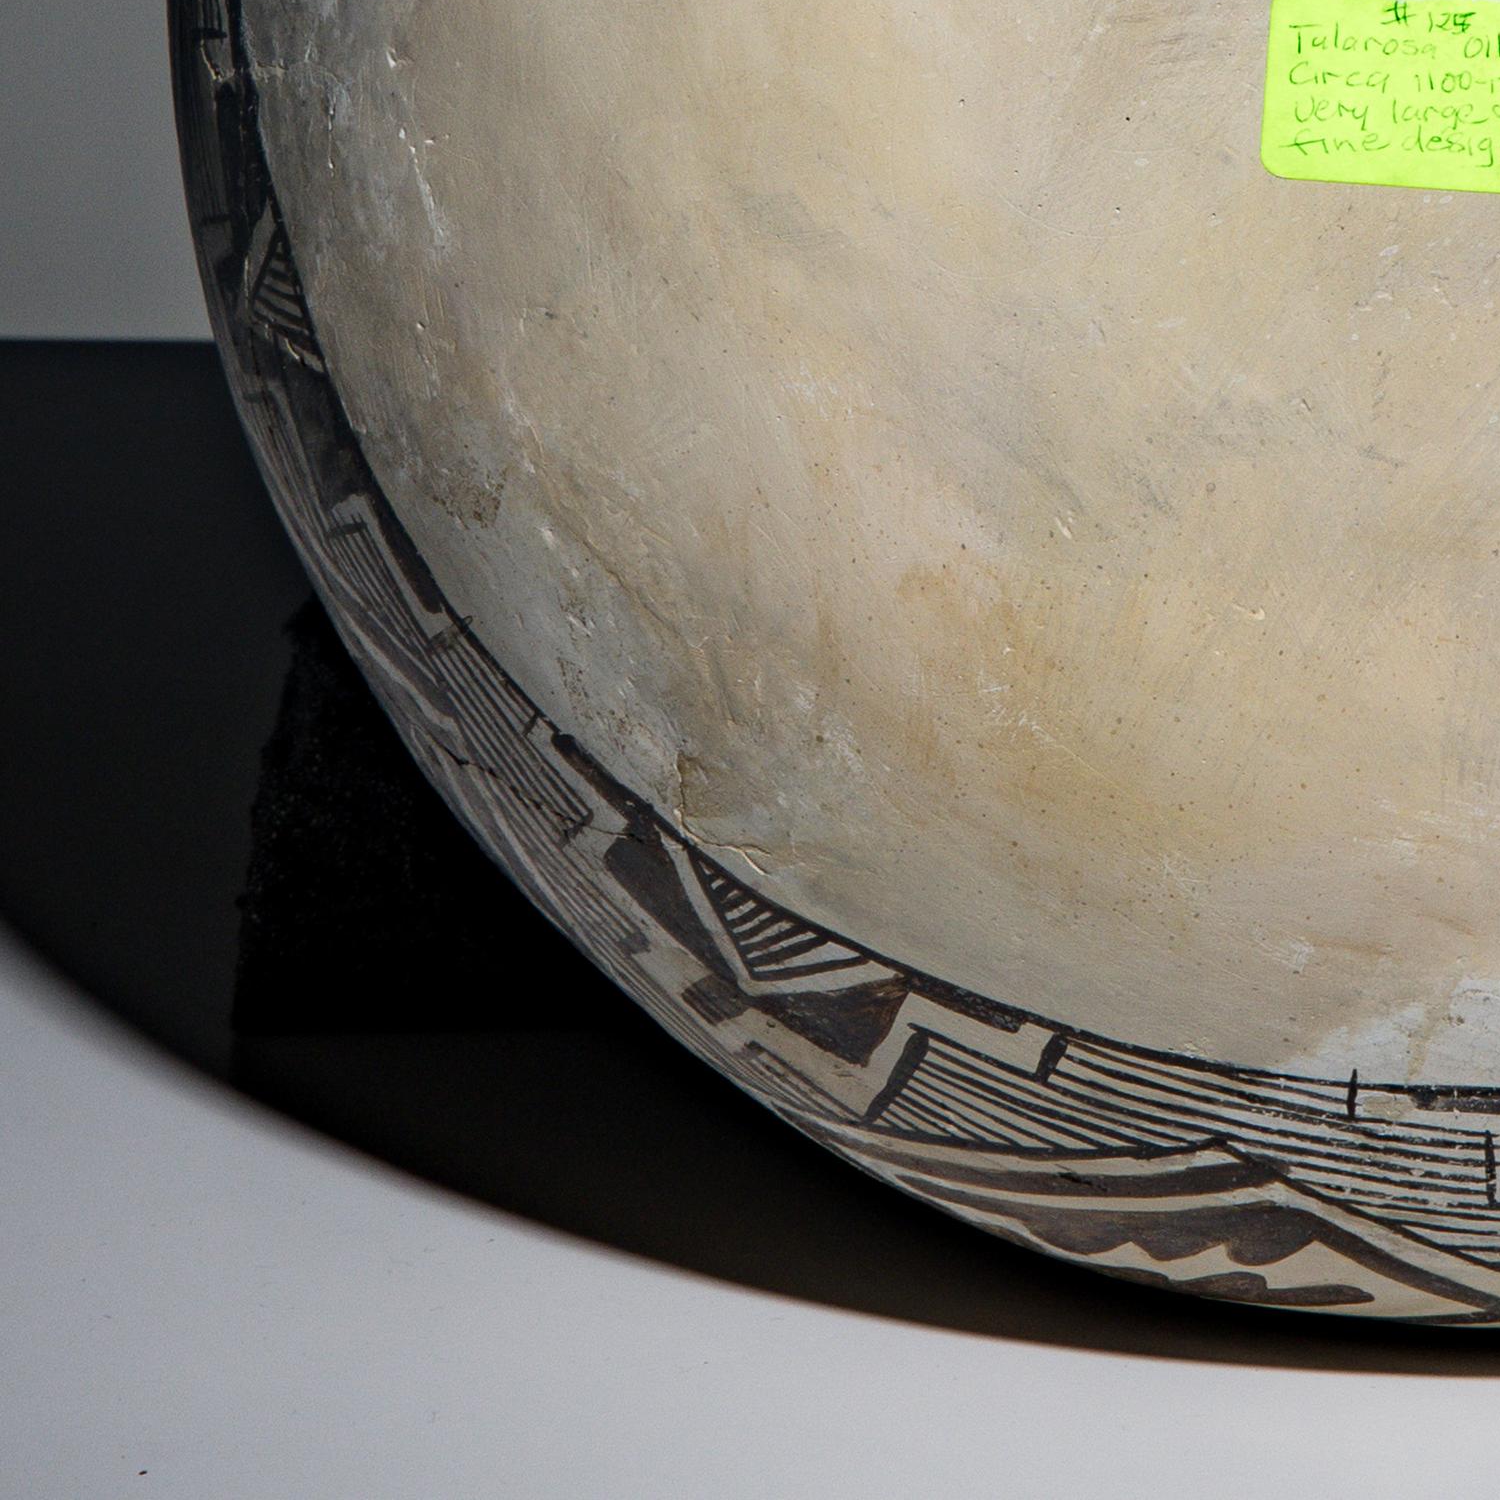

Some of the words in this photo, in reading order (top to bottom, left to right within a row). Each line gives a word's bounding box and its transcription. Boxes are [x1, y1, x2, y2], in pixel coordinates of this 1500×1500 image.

[1288, 23, 1437, 59] Tularosa
[1289, 61, 1390, 93] Circa
[1392, 98, 1488, 130] large
[1278, 128, 1390, 155] fine
